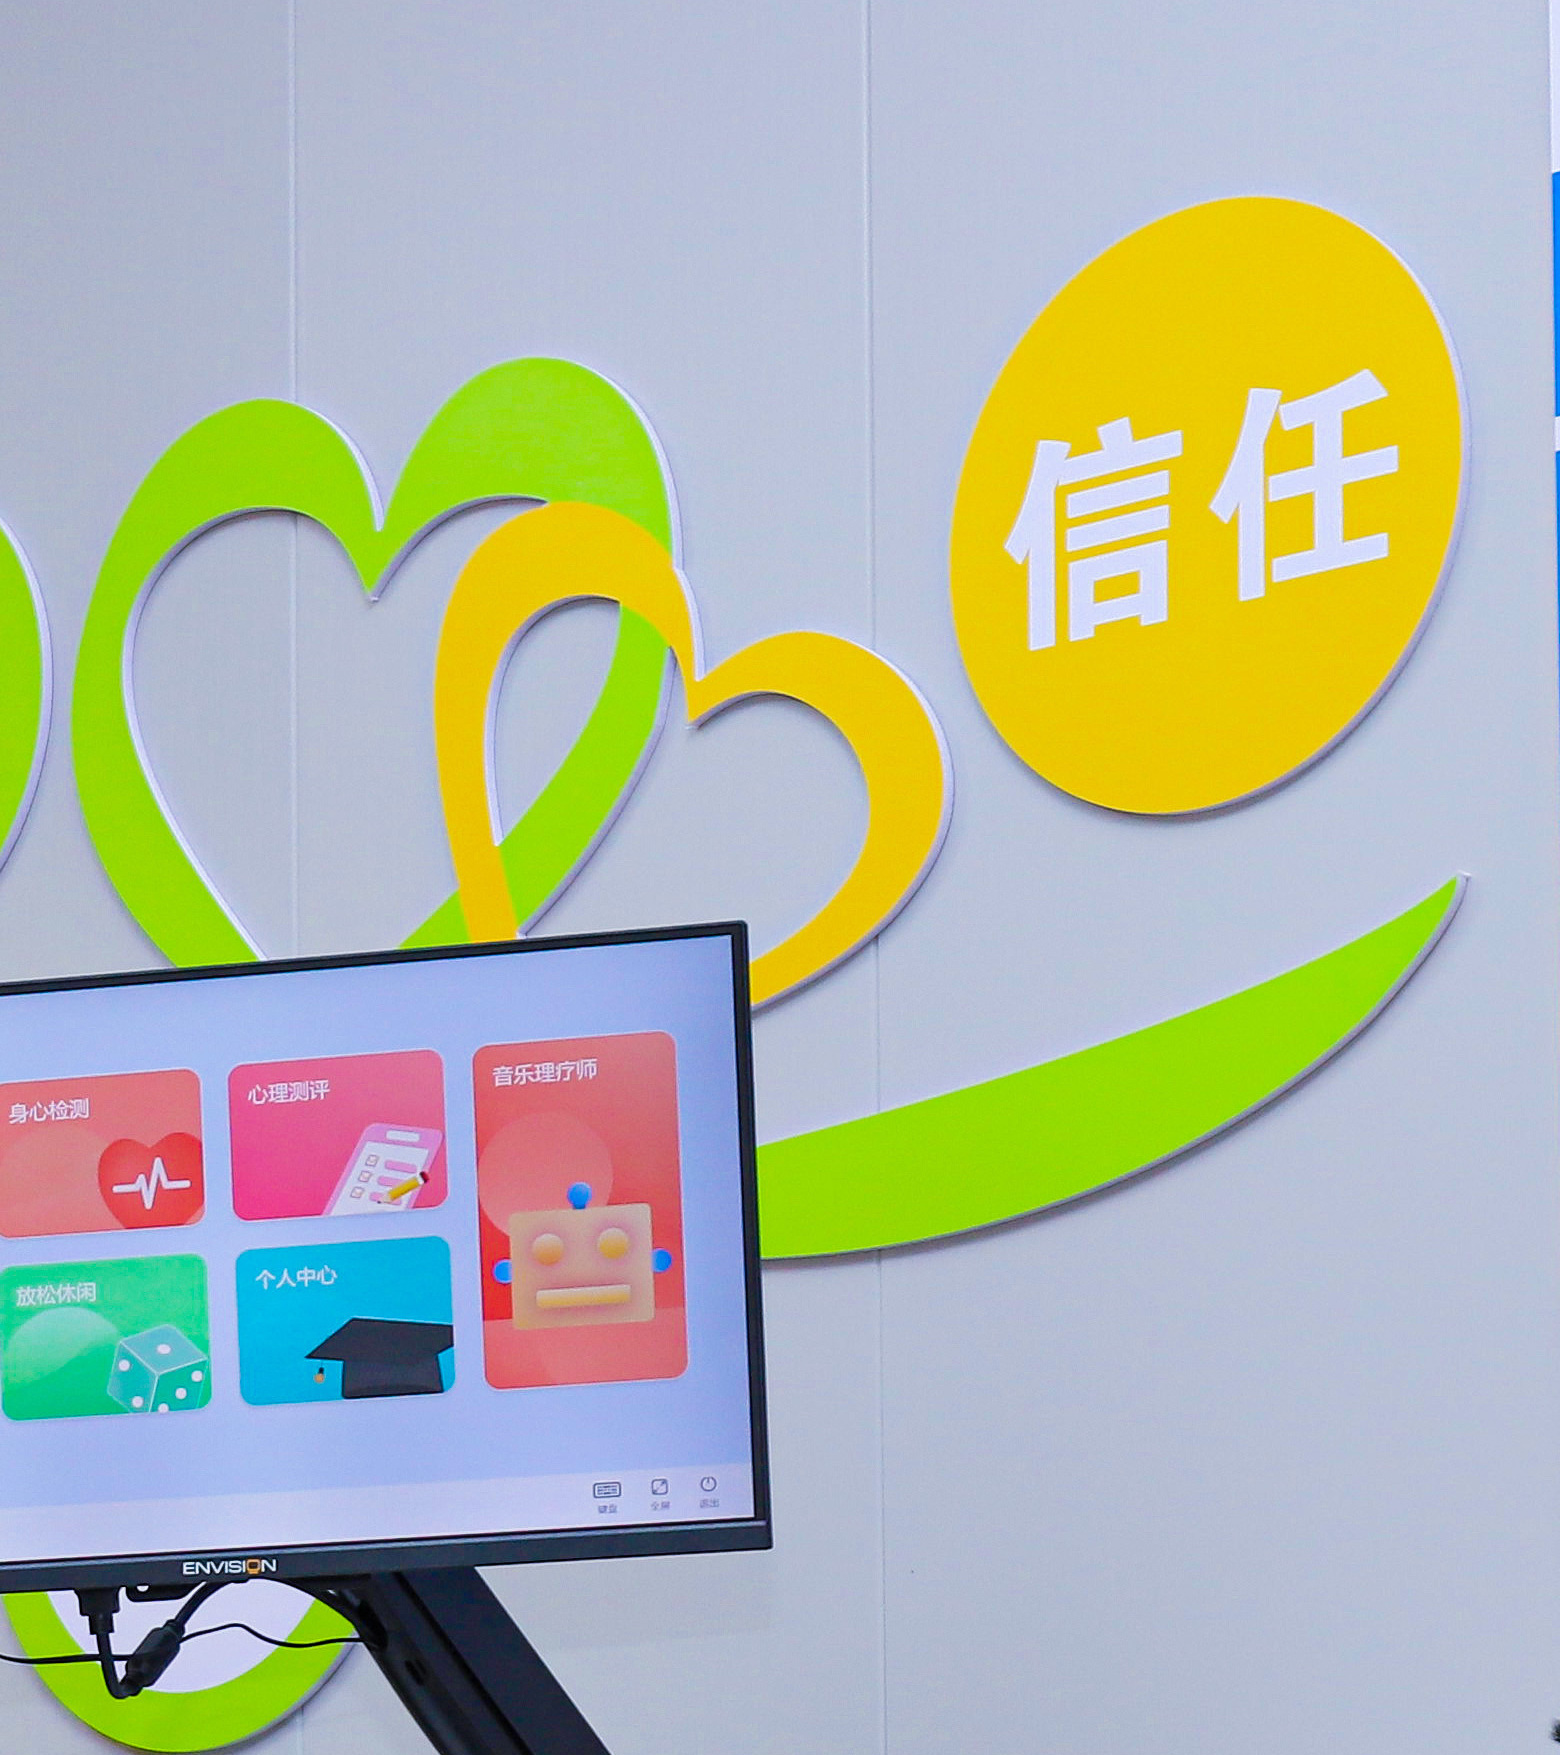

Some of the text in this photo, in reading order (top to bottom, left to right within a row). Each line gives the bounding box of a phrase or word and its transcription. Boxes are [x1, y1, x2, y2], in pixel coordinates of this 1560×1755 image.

[1004, 369, 1399, 651] 信任
[491, 1058, 599, 1087] 音乐理疗师
[247, 1079, 331, 1105] 心理测评
[8, 1097, 90, 1124] 身心检测
[255, 1264, 338, 1290] 个人中心
[15, 1281, 98, 1307] 放松休闲
[182, 1559, 277, 1575] ENVISION
